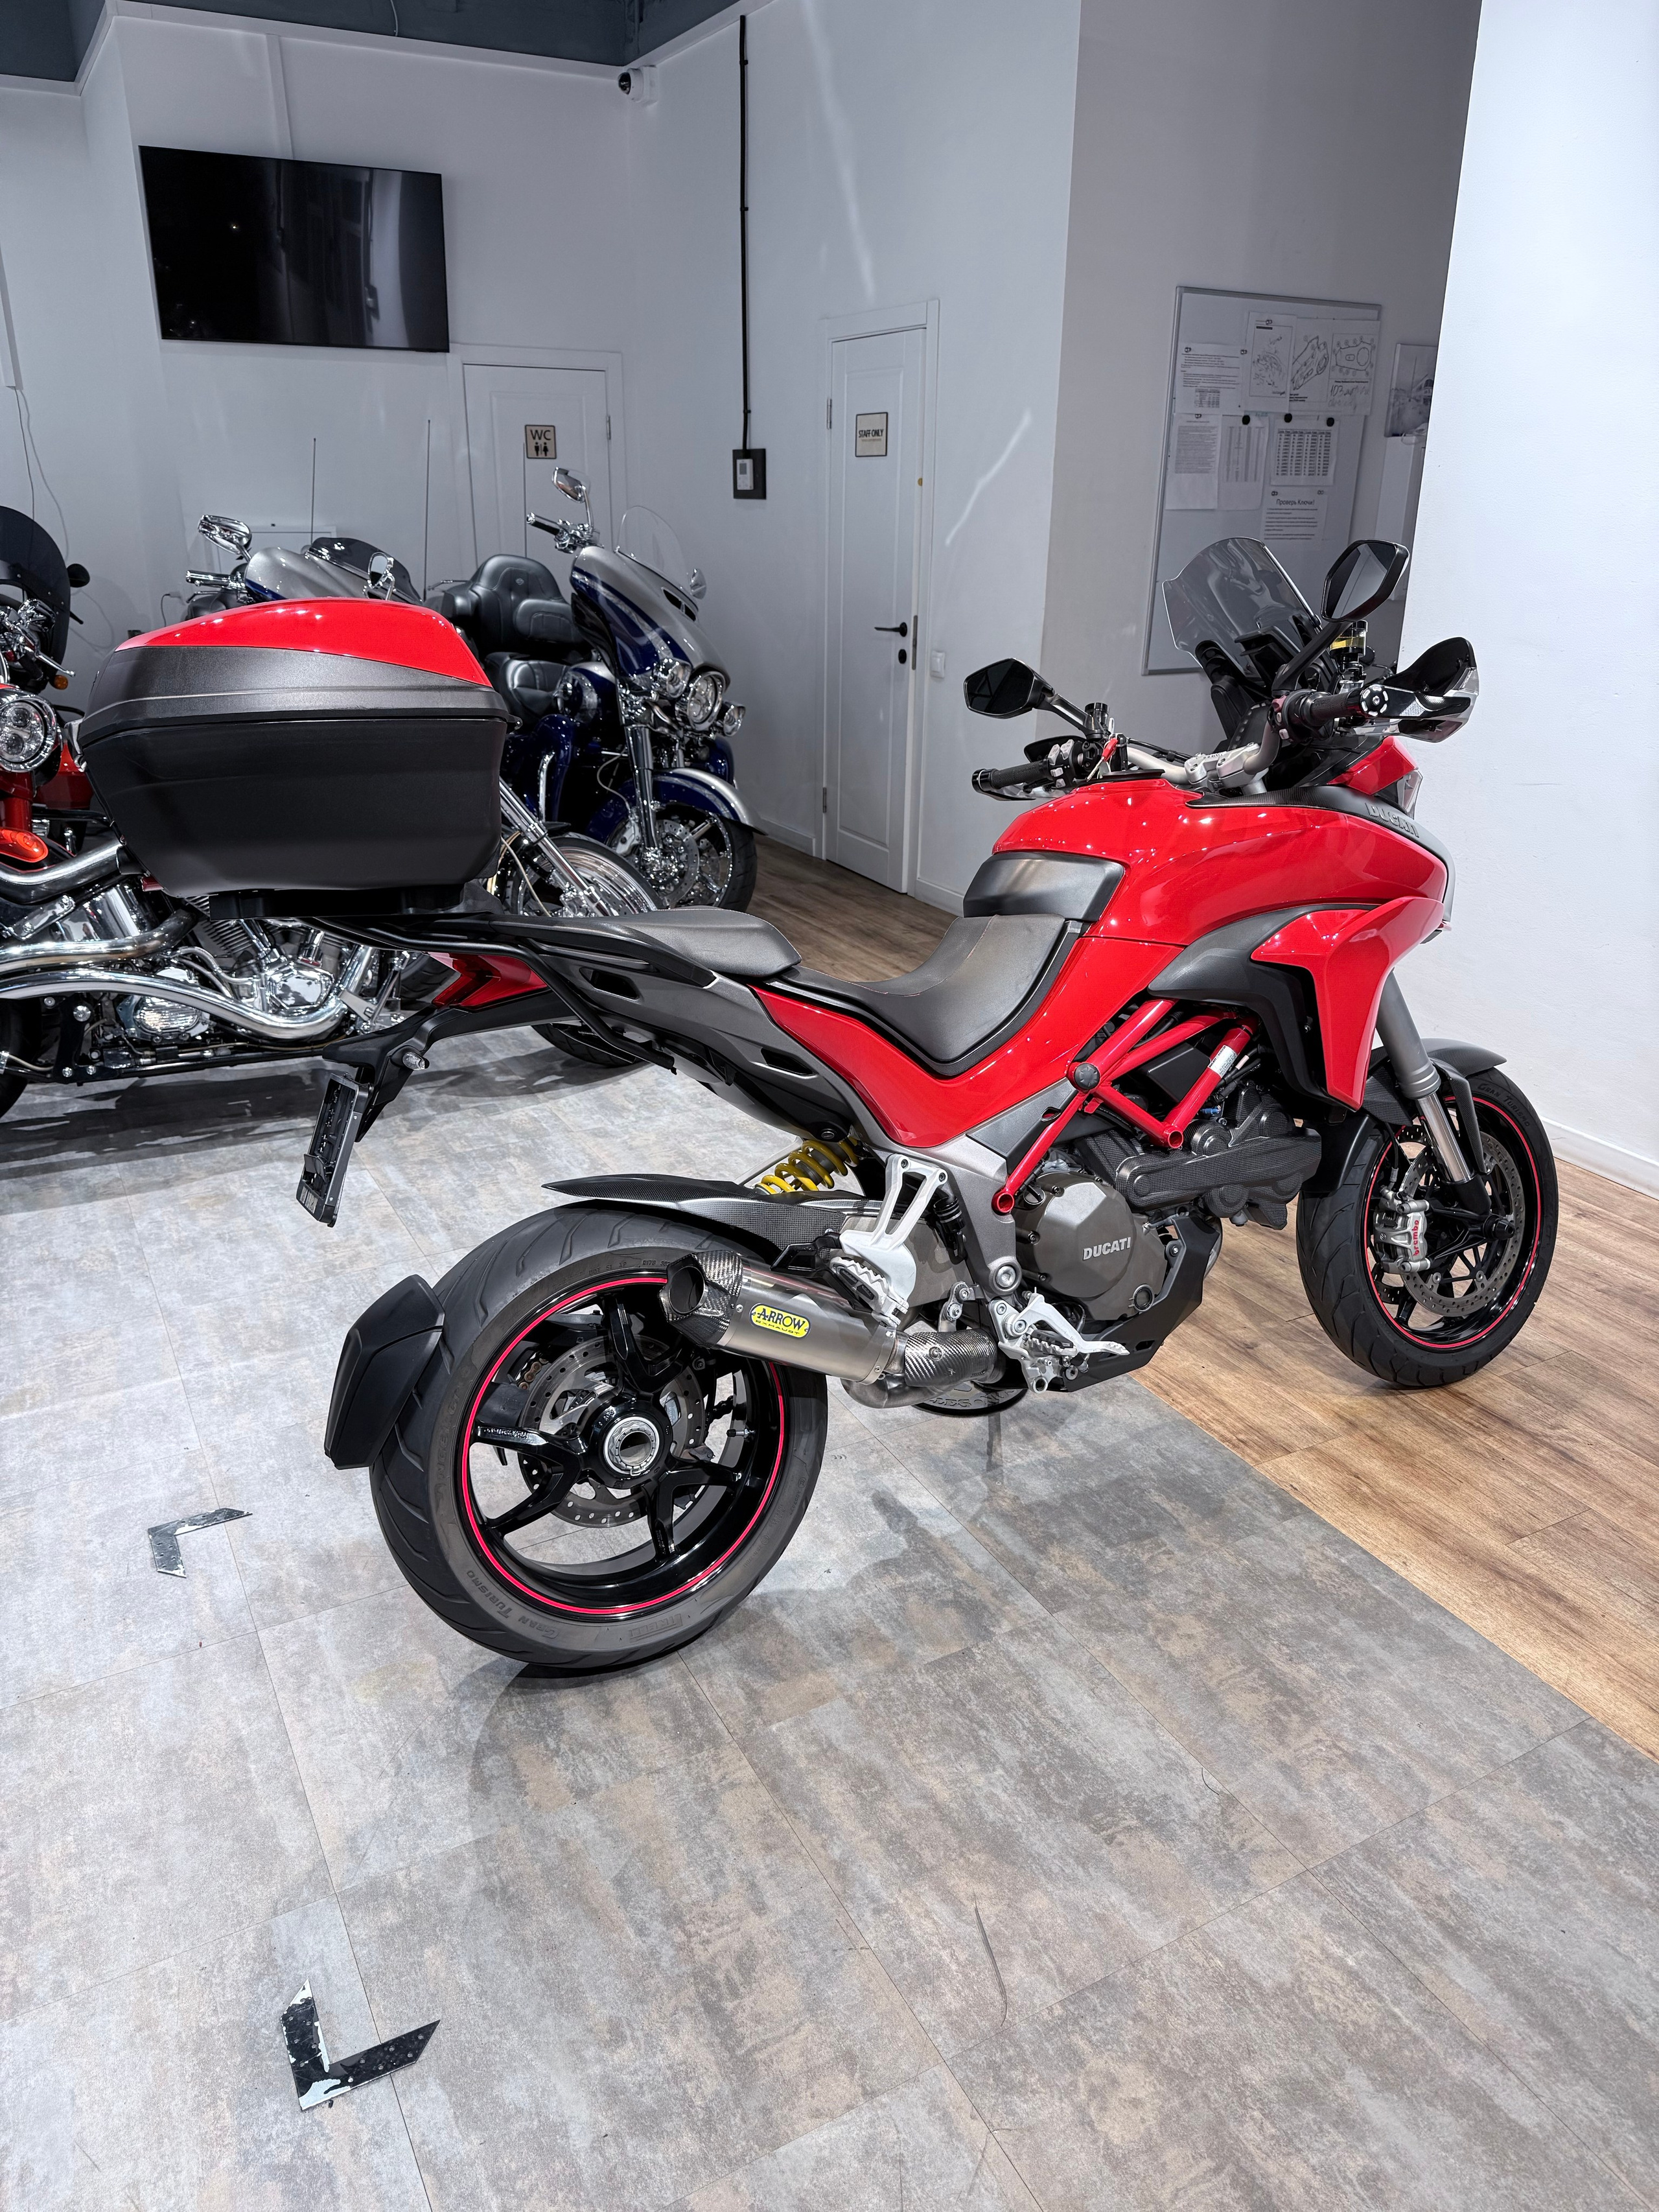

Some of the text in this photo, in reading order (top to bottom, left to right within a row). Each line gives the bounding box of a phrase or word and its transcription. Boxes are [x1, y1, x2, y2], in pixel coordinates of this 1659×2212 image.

[530, 429, 551, 441] WC
[858, 428, 884, 437] STAFF ONLY
[1364, 802, 1420, 838] DUCATI
[1082, 1237, 1131, 1261] DUCATI
[1411, 1219, 1420, 1257] brembo
[756, 1320, 800, 1334] EXHAUST
[757, 1308, 806, 1331] ARROW
[628, 1613, 683, 1644] PIRELLI
